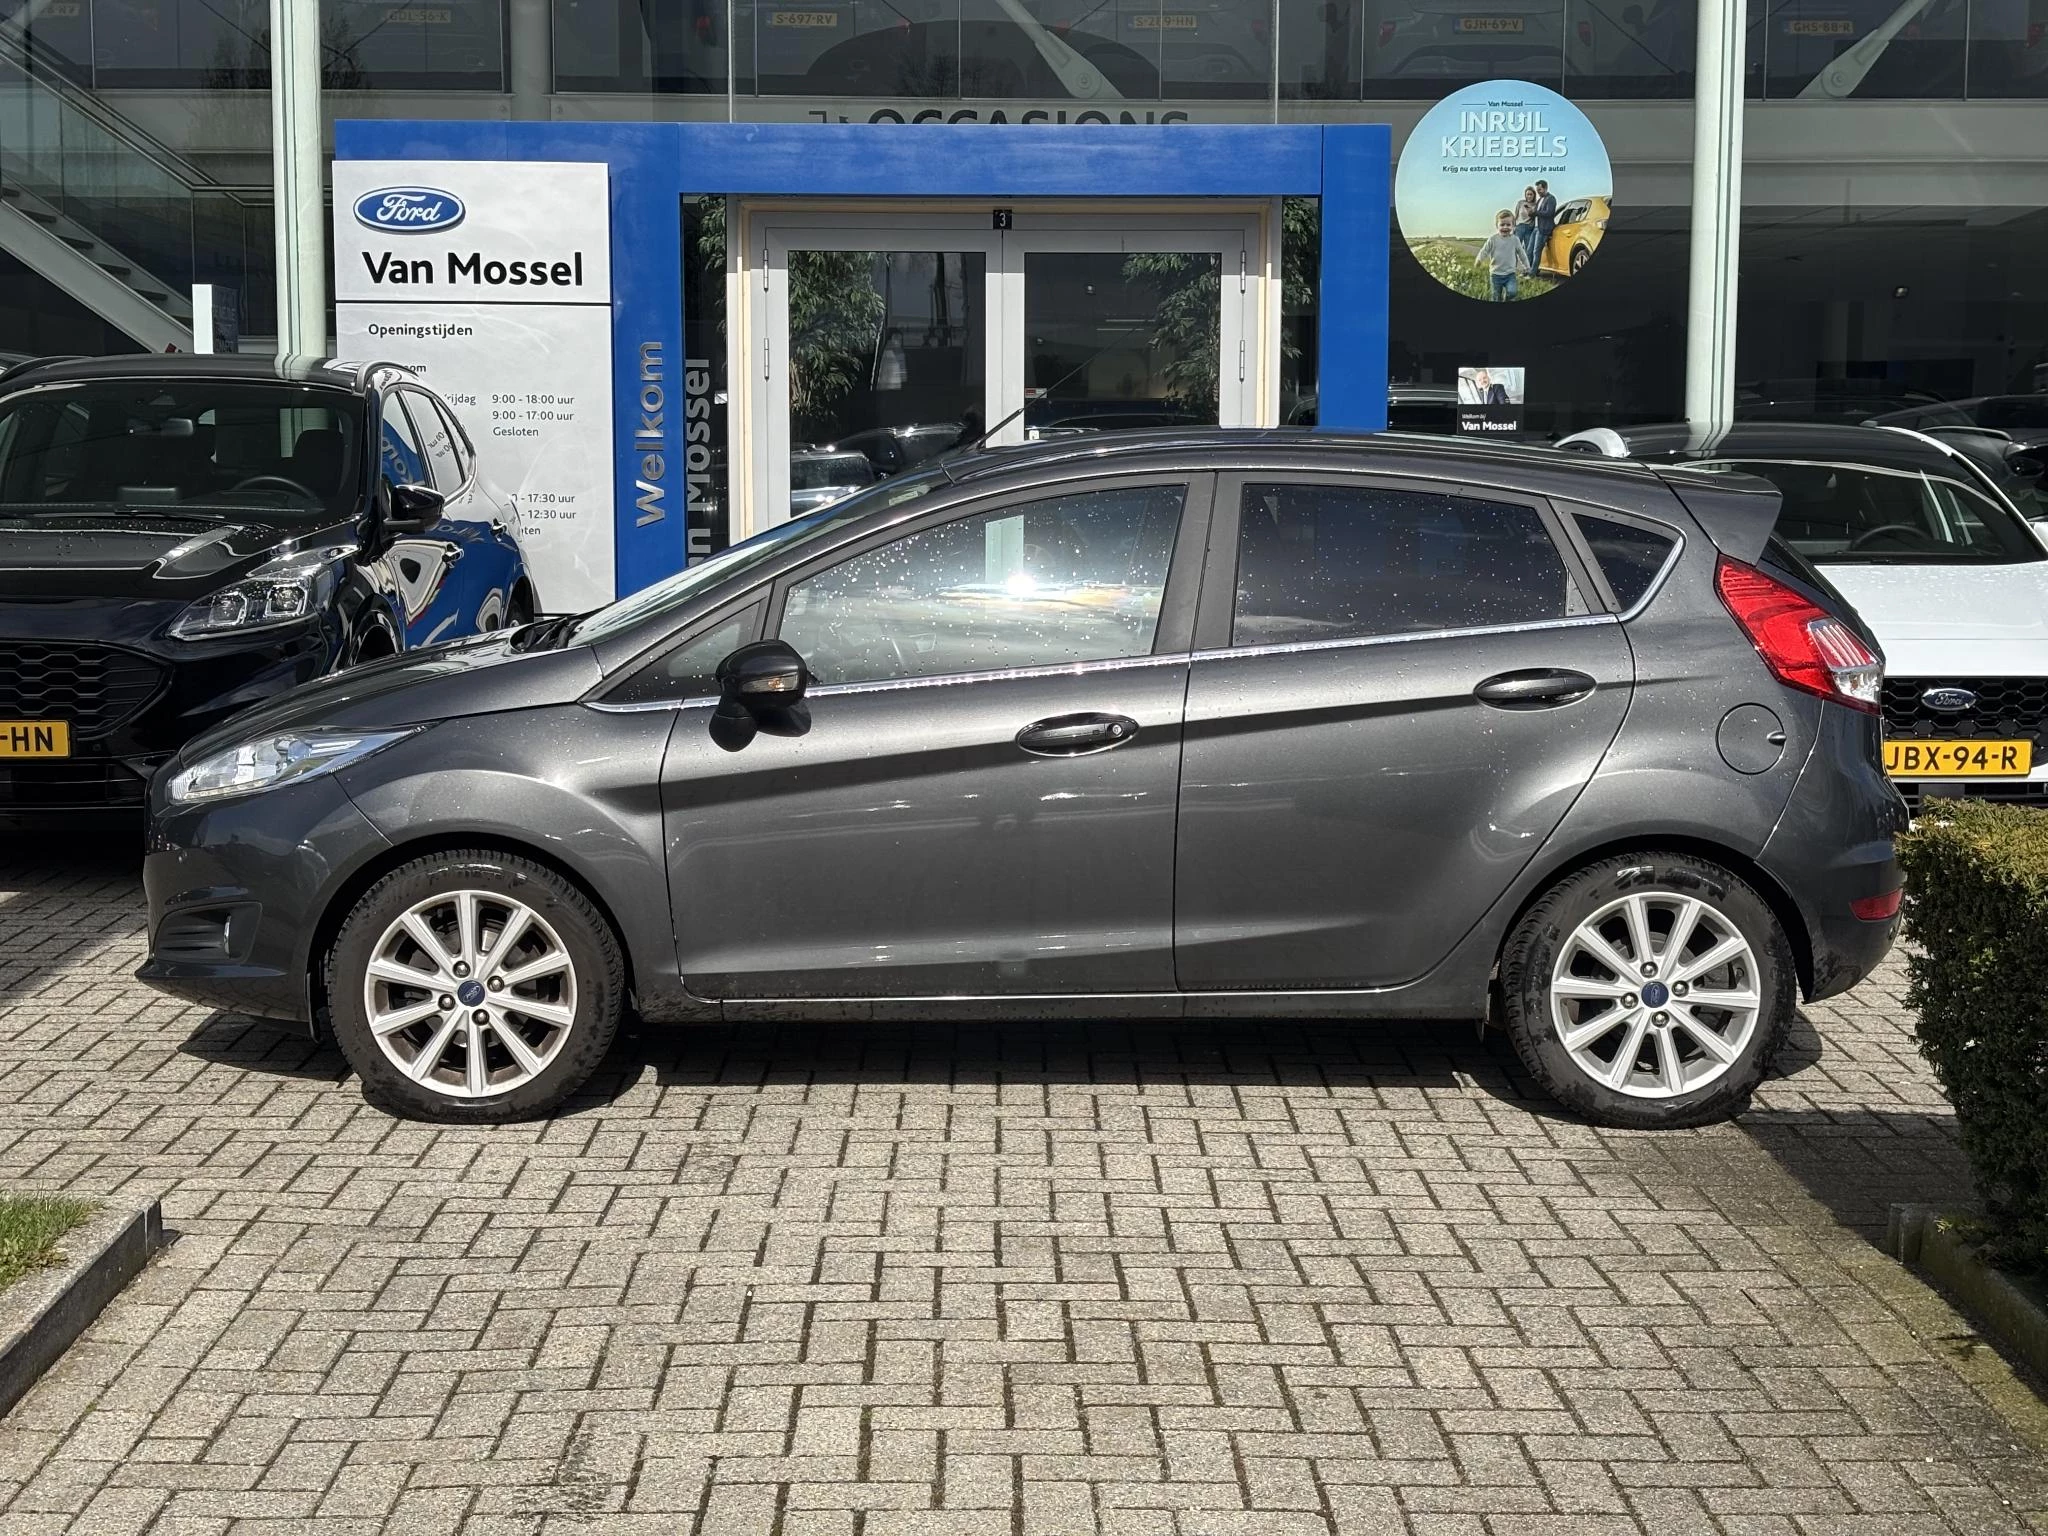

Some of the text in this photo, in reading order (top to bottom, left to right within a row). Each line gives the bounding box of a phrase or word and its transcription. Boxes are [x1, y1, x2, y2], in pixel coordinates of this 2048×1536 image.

[775, 13, 833, 25] S-697-RV
[1464, 18, 1519, 30] GJH-69-V
[1460, 111, 1550, 133] INRUIL
[1441, 136, 1568, 158] KRIEBELS
[376, 194, 441, 222] Ford
[1000, 212, 1006, 227] 3
[362, 252, 583, 286] Van Mossel
[368, 323, 473, 338] Openingstijden
[444, 394, 476, 406] rijdag
[492, 394, 516, 404] 9:00
[526, 394, 554, 405] 18:00
[557, 397, 575, 405] uur
[492, 410, 516, 420] 9:00
[526, 410, 554, 421] 17:00
[556, 413, 575, 421] uur
[492, 426, 539, 437] Gesloten
[1462, 420, 1517, 431] Van Mossel
[635, 341, 665, 527] Welkom
[685, 359, 711, 512] Mossel
[528, 493, 556, 503] 17:30
[558, 495, 576, 503] uur
[527, 509, 557, 519] 12:30
[559, 511, 577, 520] uur
[1886, 746, 2018, 770] JBX-94-R
